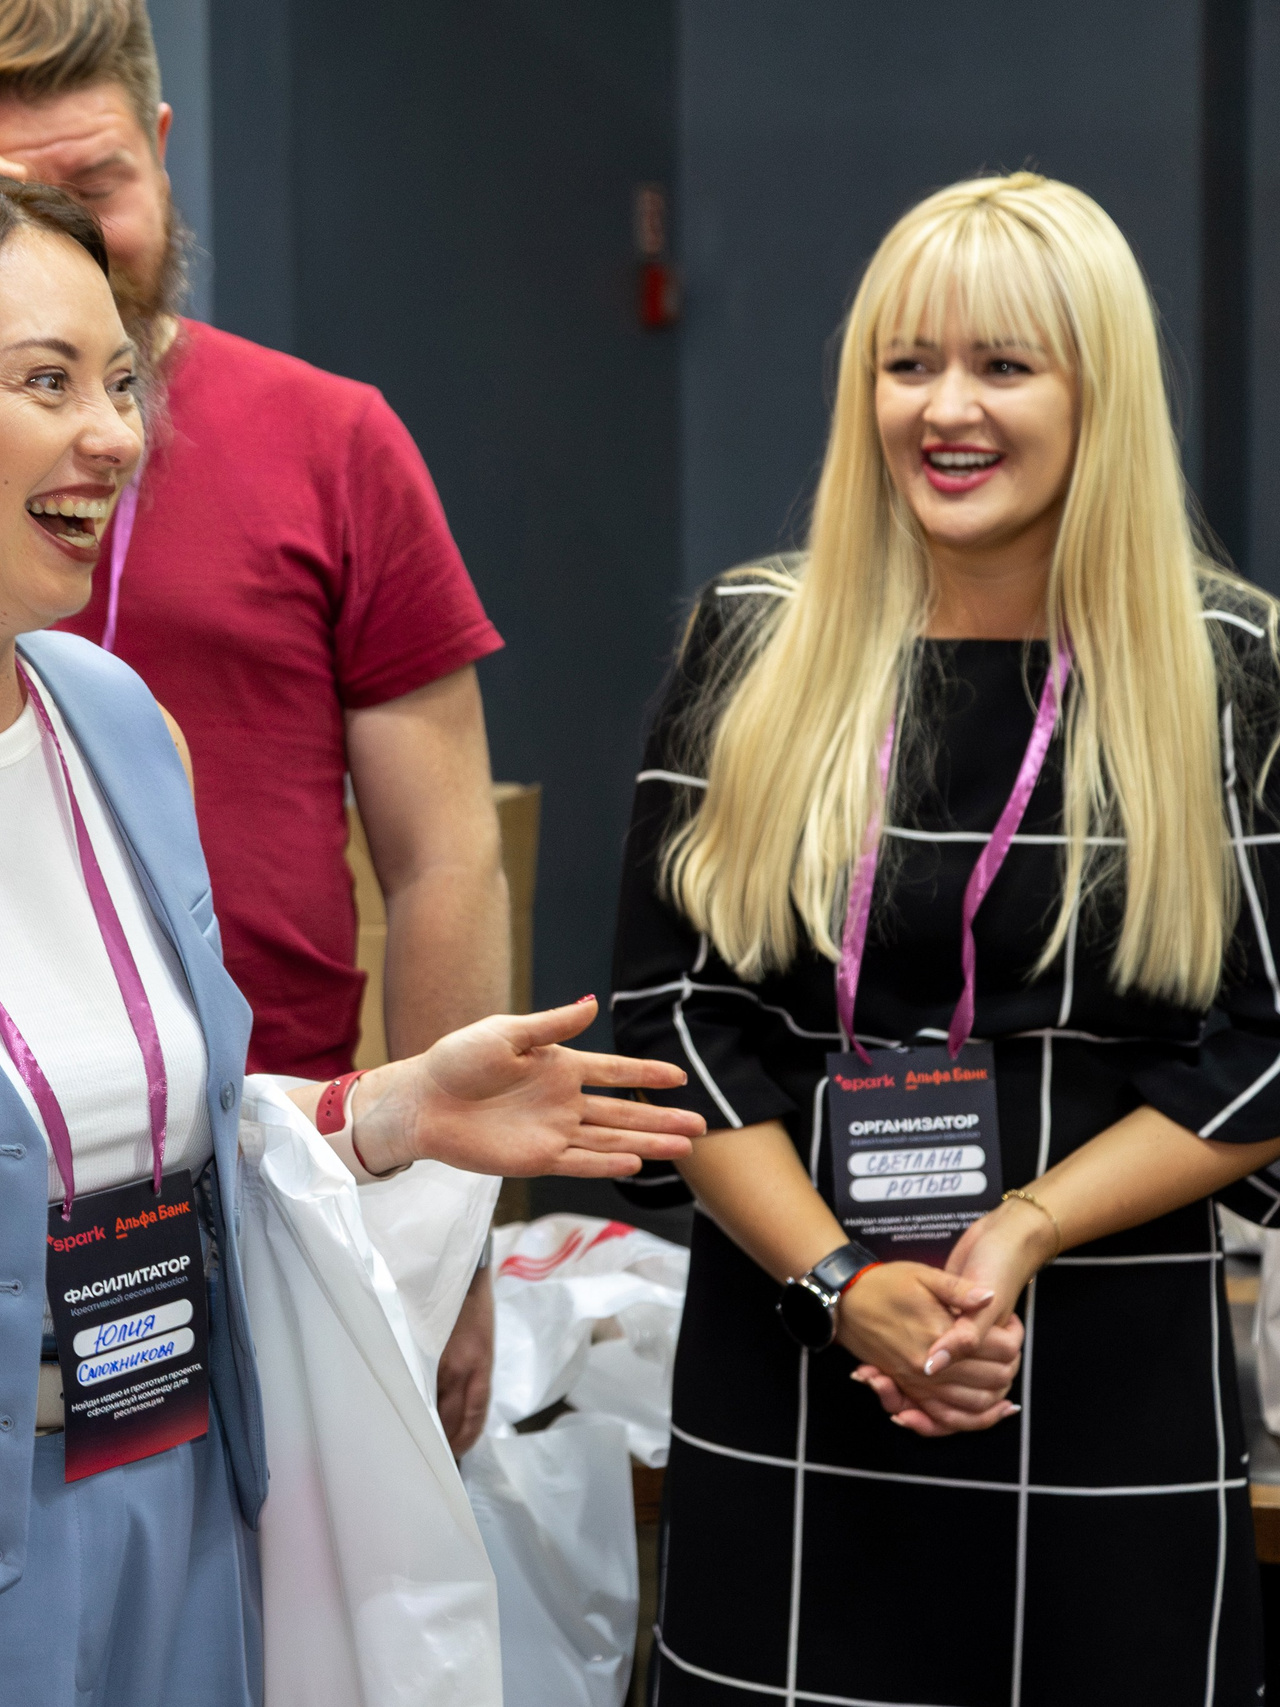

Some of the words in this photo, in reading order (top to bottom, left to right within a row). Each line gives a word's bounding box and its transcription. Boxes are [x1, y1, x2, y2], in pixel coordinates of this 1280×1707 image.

[848, 1113, 979, 1136] ОРГАНИЗАТОР
[867, 1149, 963, 1173] СВЕТЛАНА
[115, 1210, 158, 1235] Альфа
[158, 1201, 191, 1220] Банк
[52, 1226, 106, 1252] spark
[64, 1255, 191, 1304] ФАСИЛИТАТОР
[70, 1294, 124, 1317] Креативной
[155, 1275, 189, 1291] Ideation
[71, 1398, 99, 1413] Найди
[100, 1390, 123, 1403] идею
[130, 1375, 169, 1394] прототип
[87, 1394, 138, 1418] сформируй
[138, 1384, 173, 1400] команду
[172, 1377, 189, 1390] для
[113, 1396, 165, 1420] реализации
